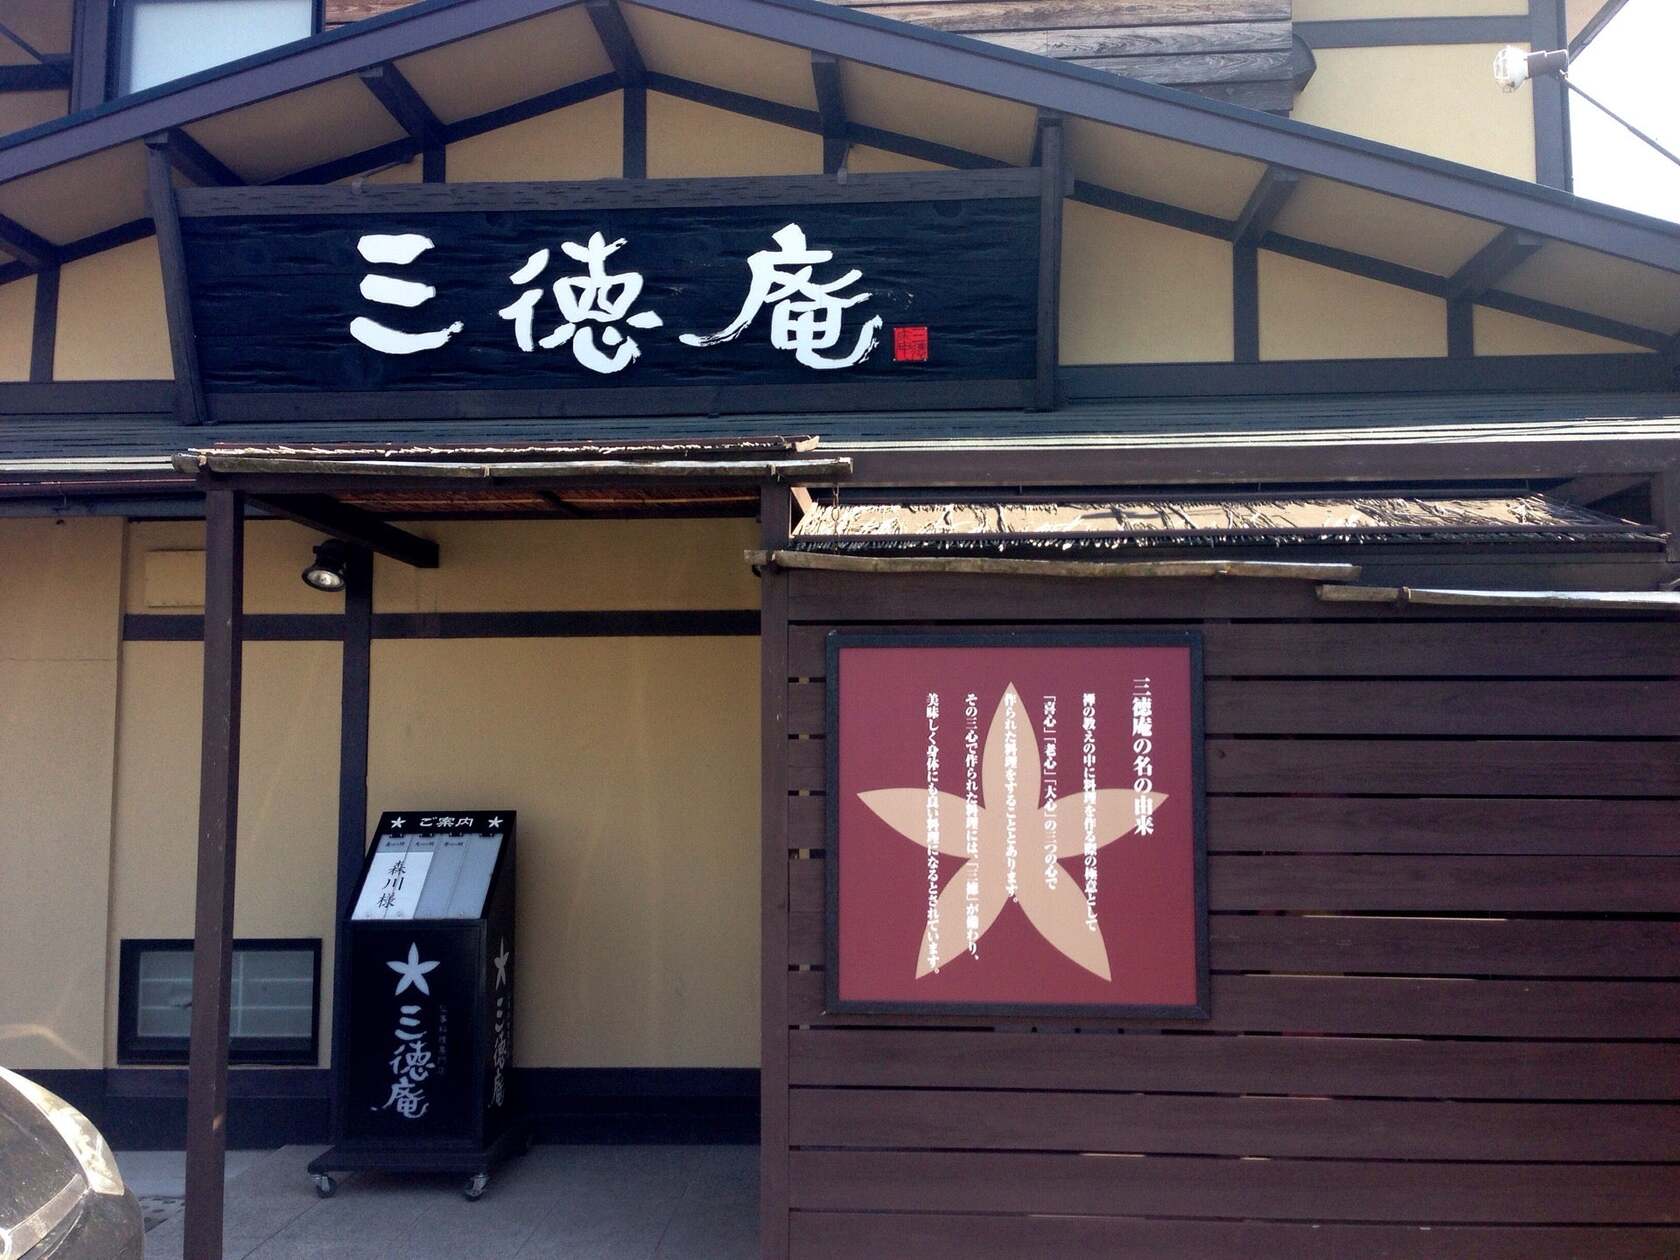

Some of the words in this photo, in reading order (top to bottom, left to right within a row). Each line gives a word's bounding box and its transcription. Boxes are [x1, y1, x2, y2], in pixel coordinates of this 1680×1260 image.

[349, 223, 883, 374] 三徳庵
[1132, 677, 1154, 836] 三徳庵の名の由来
[419, 816, 474, 828] ご案内
[376, 860, 406, 909] 森川様
[370, 1005, 436, 1119] 三徳庵
